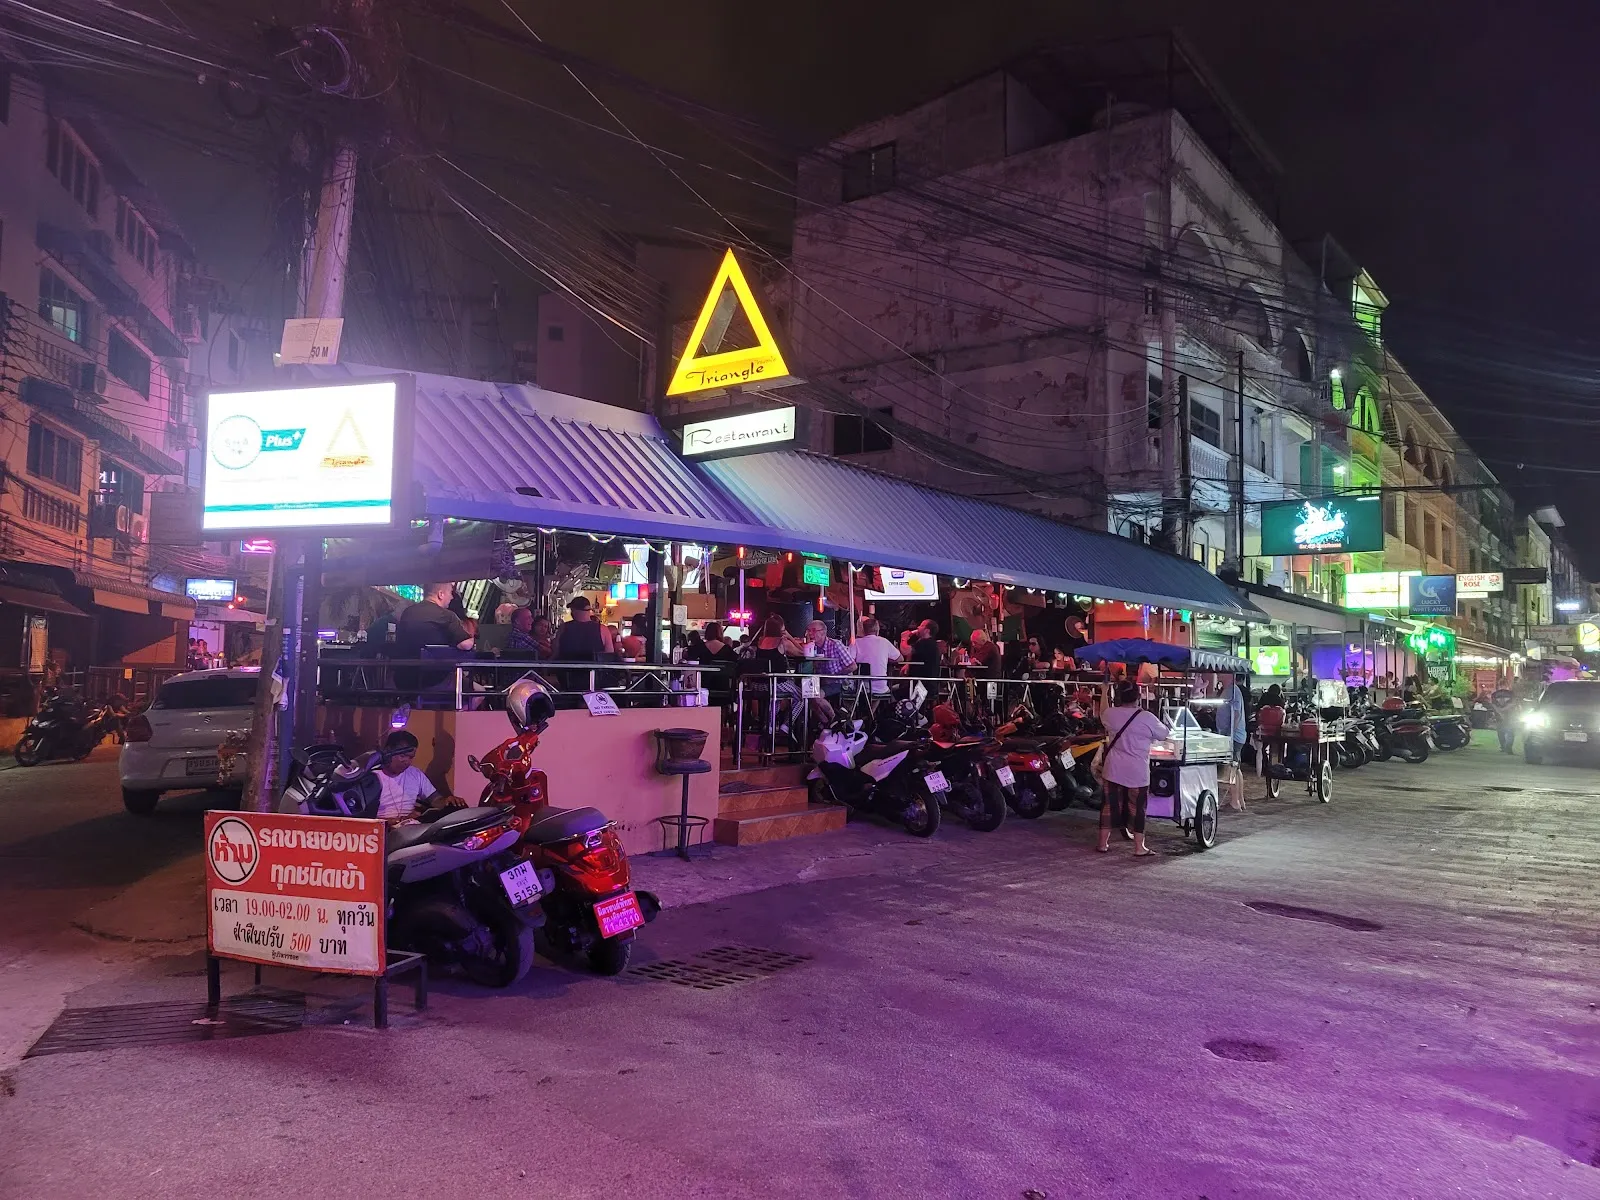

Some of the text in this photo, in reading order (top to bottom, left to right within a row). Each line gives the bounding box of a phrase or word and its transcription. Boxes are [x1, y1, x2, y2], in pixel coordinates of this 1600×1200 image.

[310, 346, 329, 358] 50 M
[685, 362, 764, 386] Triangle
[685, 422, 789, 447] Restaurant
[214, 833, 254, 865] ห้าม
[259, 827, 379, 854] รถขายของเร่
[270, 862, 365, 891] ทุกชนิดเข้า
[513, 884, 539, 902] 5159
[214, 895, 375, 934] เวลา 19.00-02.00 น. ทุกวัน
[604, 912, 641, 933] 11-4310
[233, 921, 347, 955] ฝ่าฝืนปรับ 500 บาท
